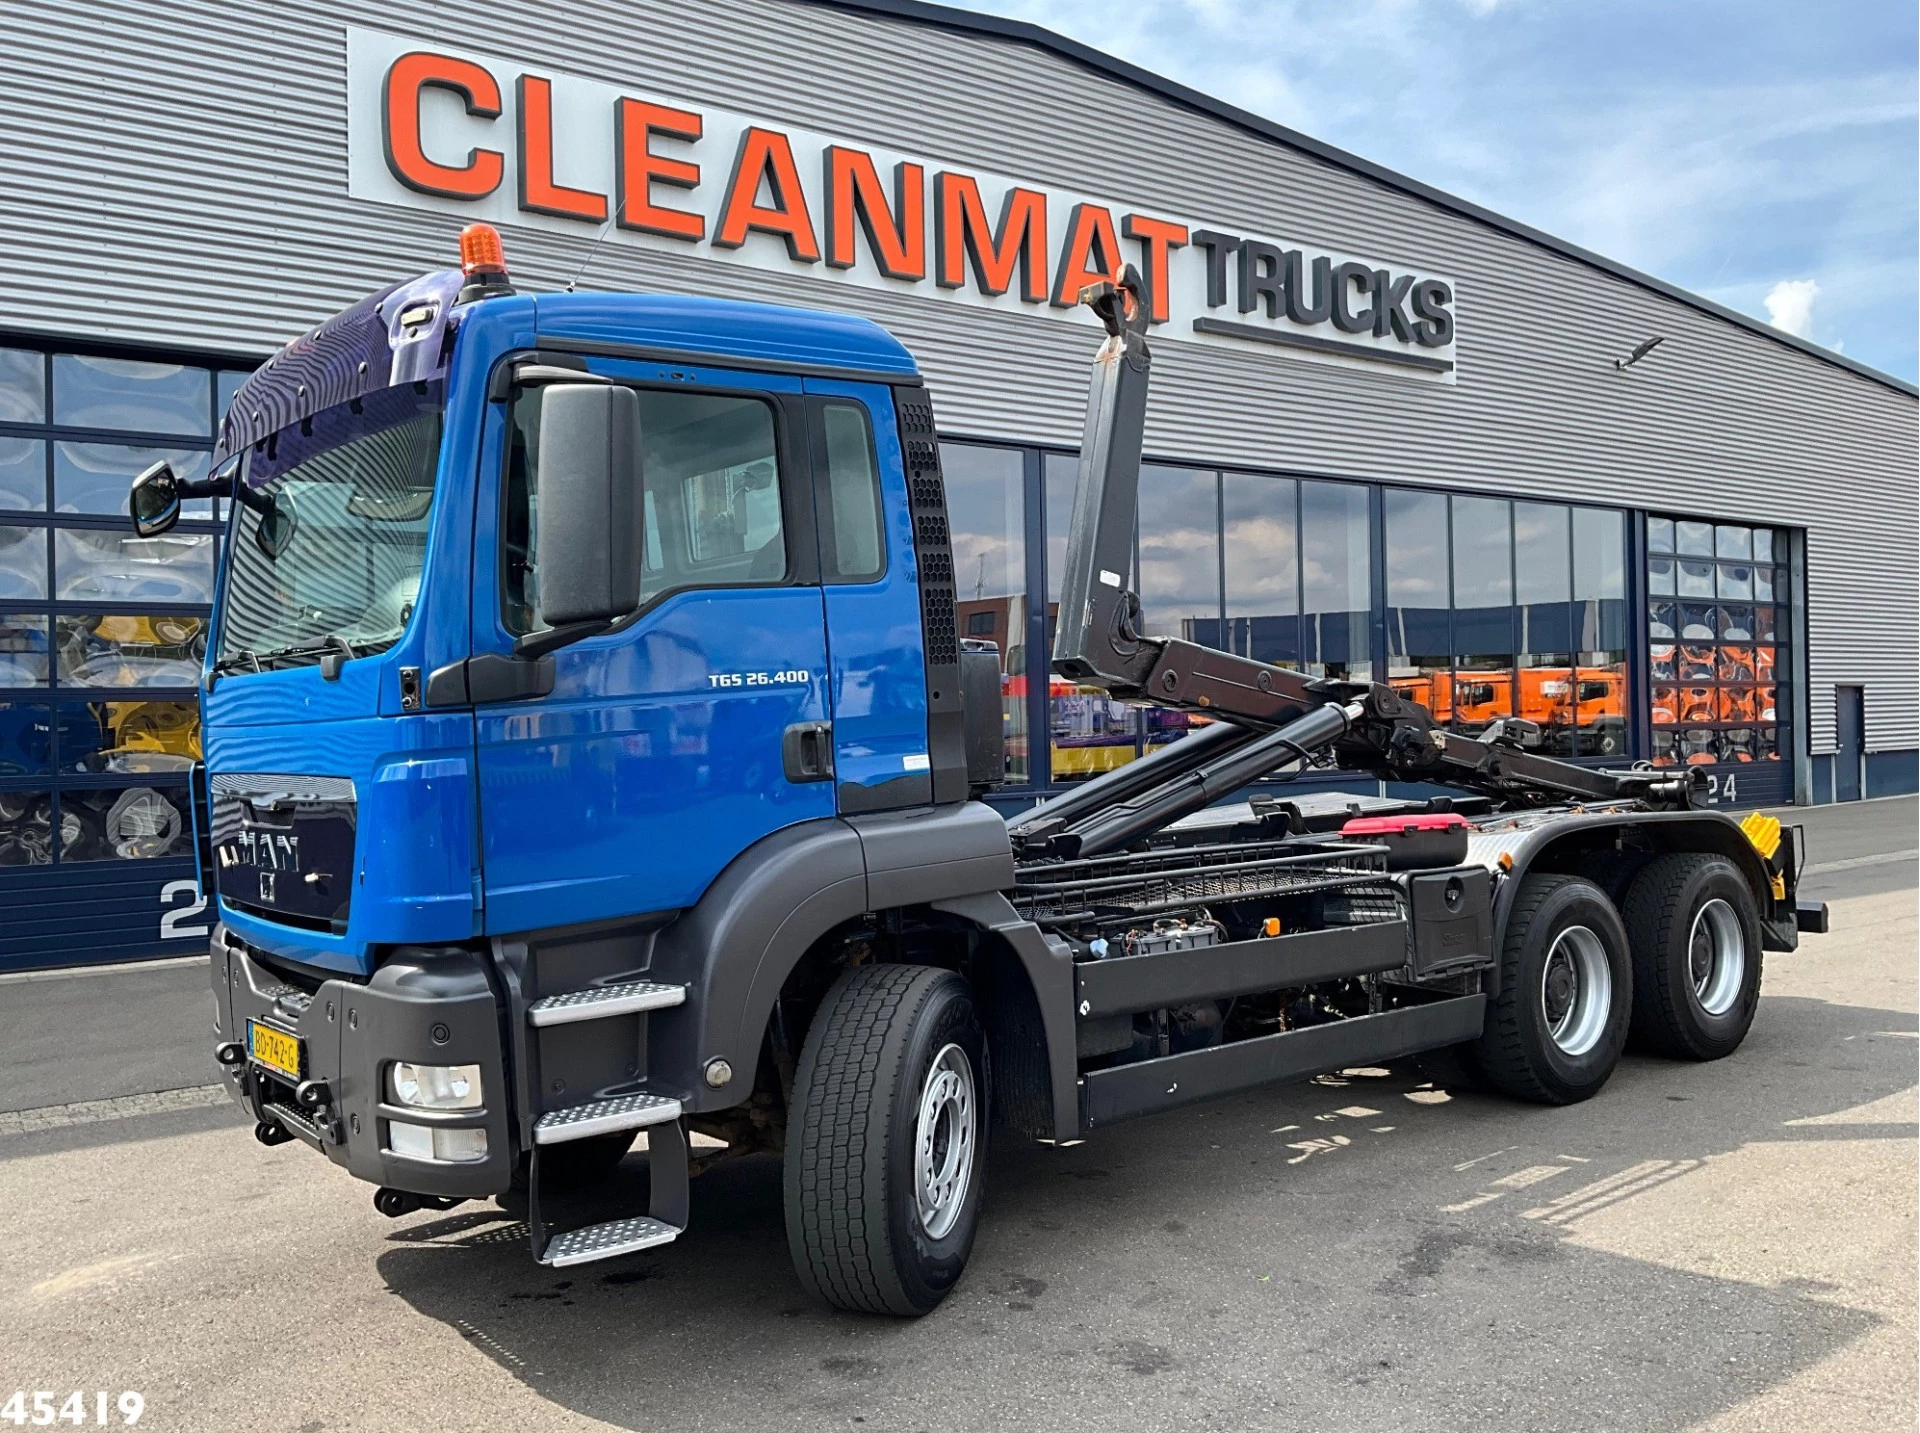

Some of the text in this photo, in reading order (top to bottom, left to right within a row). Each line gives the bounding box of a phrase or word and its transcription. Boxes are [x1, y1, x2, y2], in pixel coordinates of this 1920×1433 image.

[381, 50, 1454, 348] CLEANMAT TRUCKS
[708, 669, 810, 688] TGS 26.400
[1706, 773, 1737, 804] 24
[238, 830, 300, 873] MAN
[255, 1029, 295, 1069] BD-742-G
